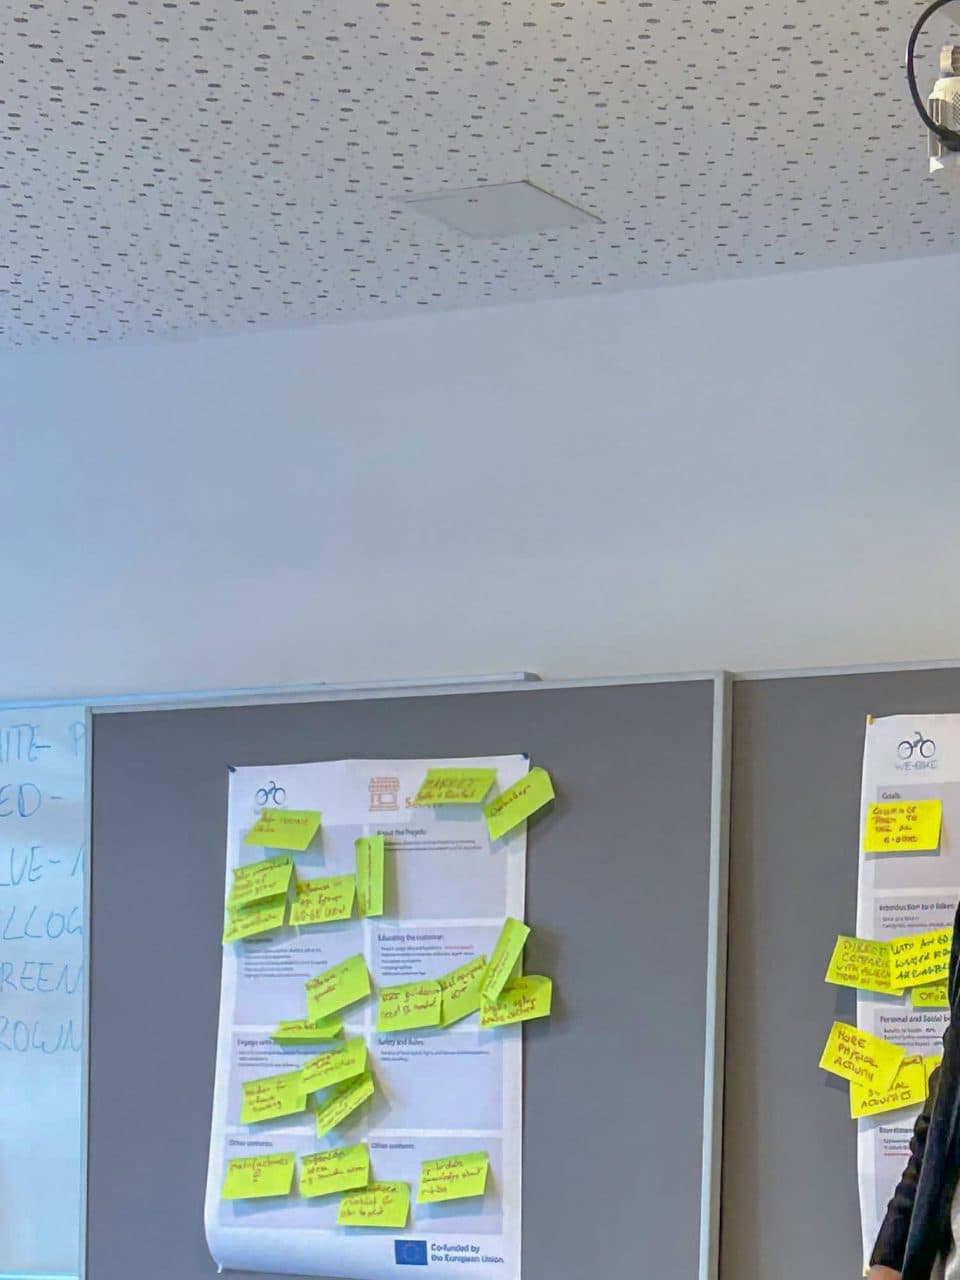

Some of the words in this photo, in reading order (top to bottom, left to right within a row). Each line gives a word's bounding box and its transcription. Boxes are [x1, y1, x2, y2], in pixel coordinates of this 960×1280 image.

[880, 1015, 908, 1023] Personal
[923, 1014, 942, 1022] Social
[431, 1243, 469, 1253] Co-funded
[470, 1243, 480, 1254] by
[431, 1254, 443, 1262] the
[444, 1254, 480, 1264] European
[481, 1255, 504, 1264] Union
